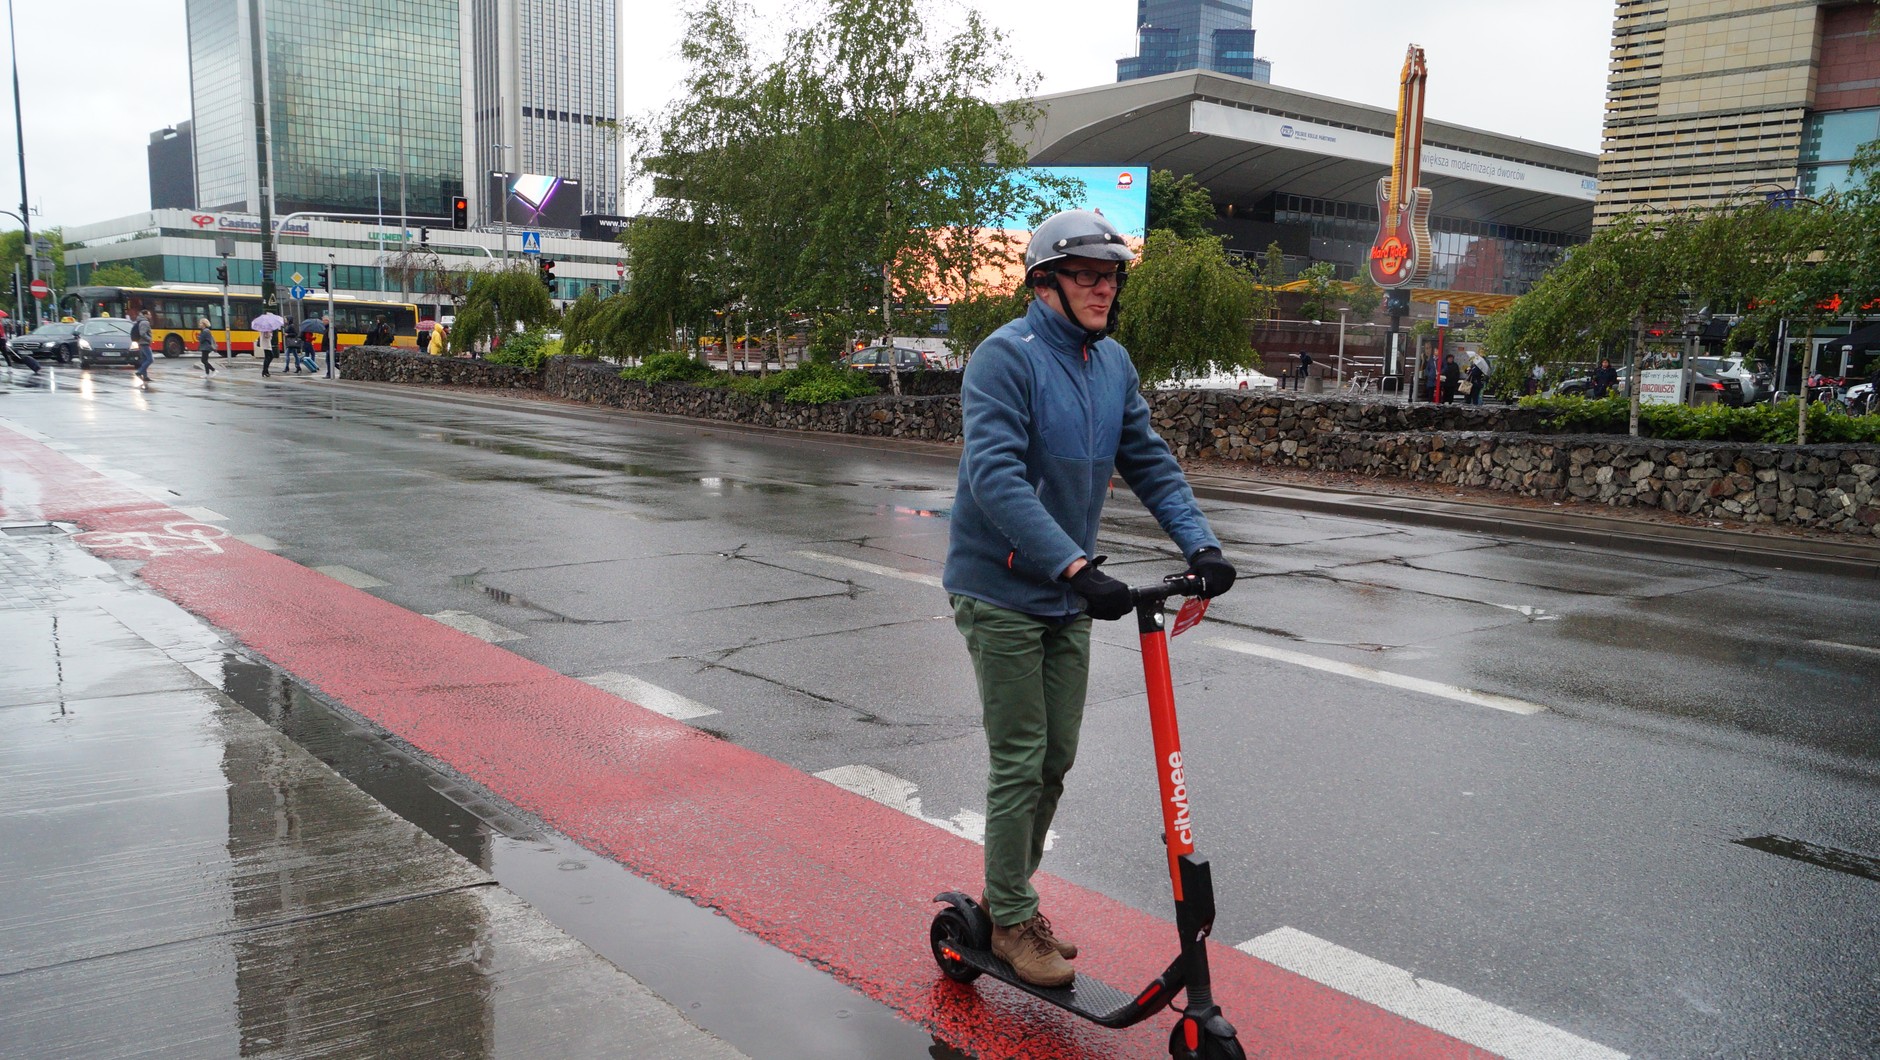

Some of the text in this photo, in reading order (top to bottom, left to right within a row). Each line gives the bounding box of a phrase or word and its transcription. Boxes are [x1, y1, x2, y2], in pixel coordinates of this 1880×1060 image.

[1451, 159, 1495, 177] modernizacja
[1497, 166, 1525, 180] dworców
[1371, 243, 1408, 259] Hard Rock
[1168, 750, 1193, 845] citybee
